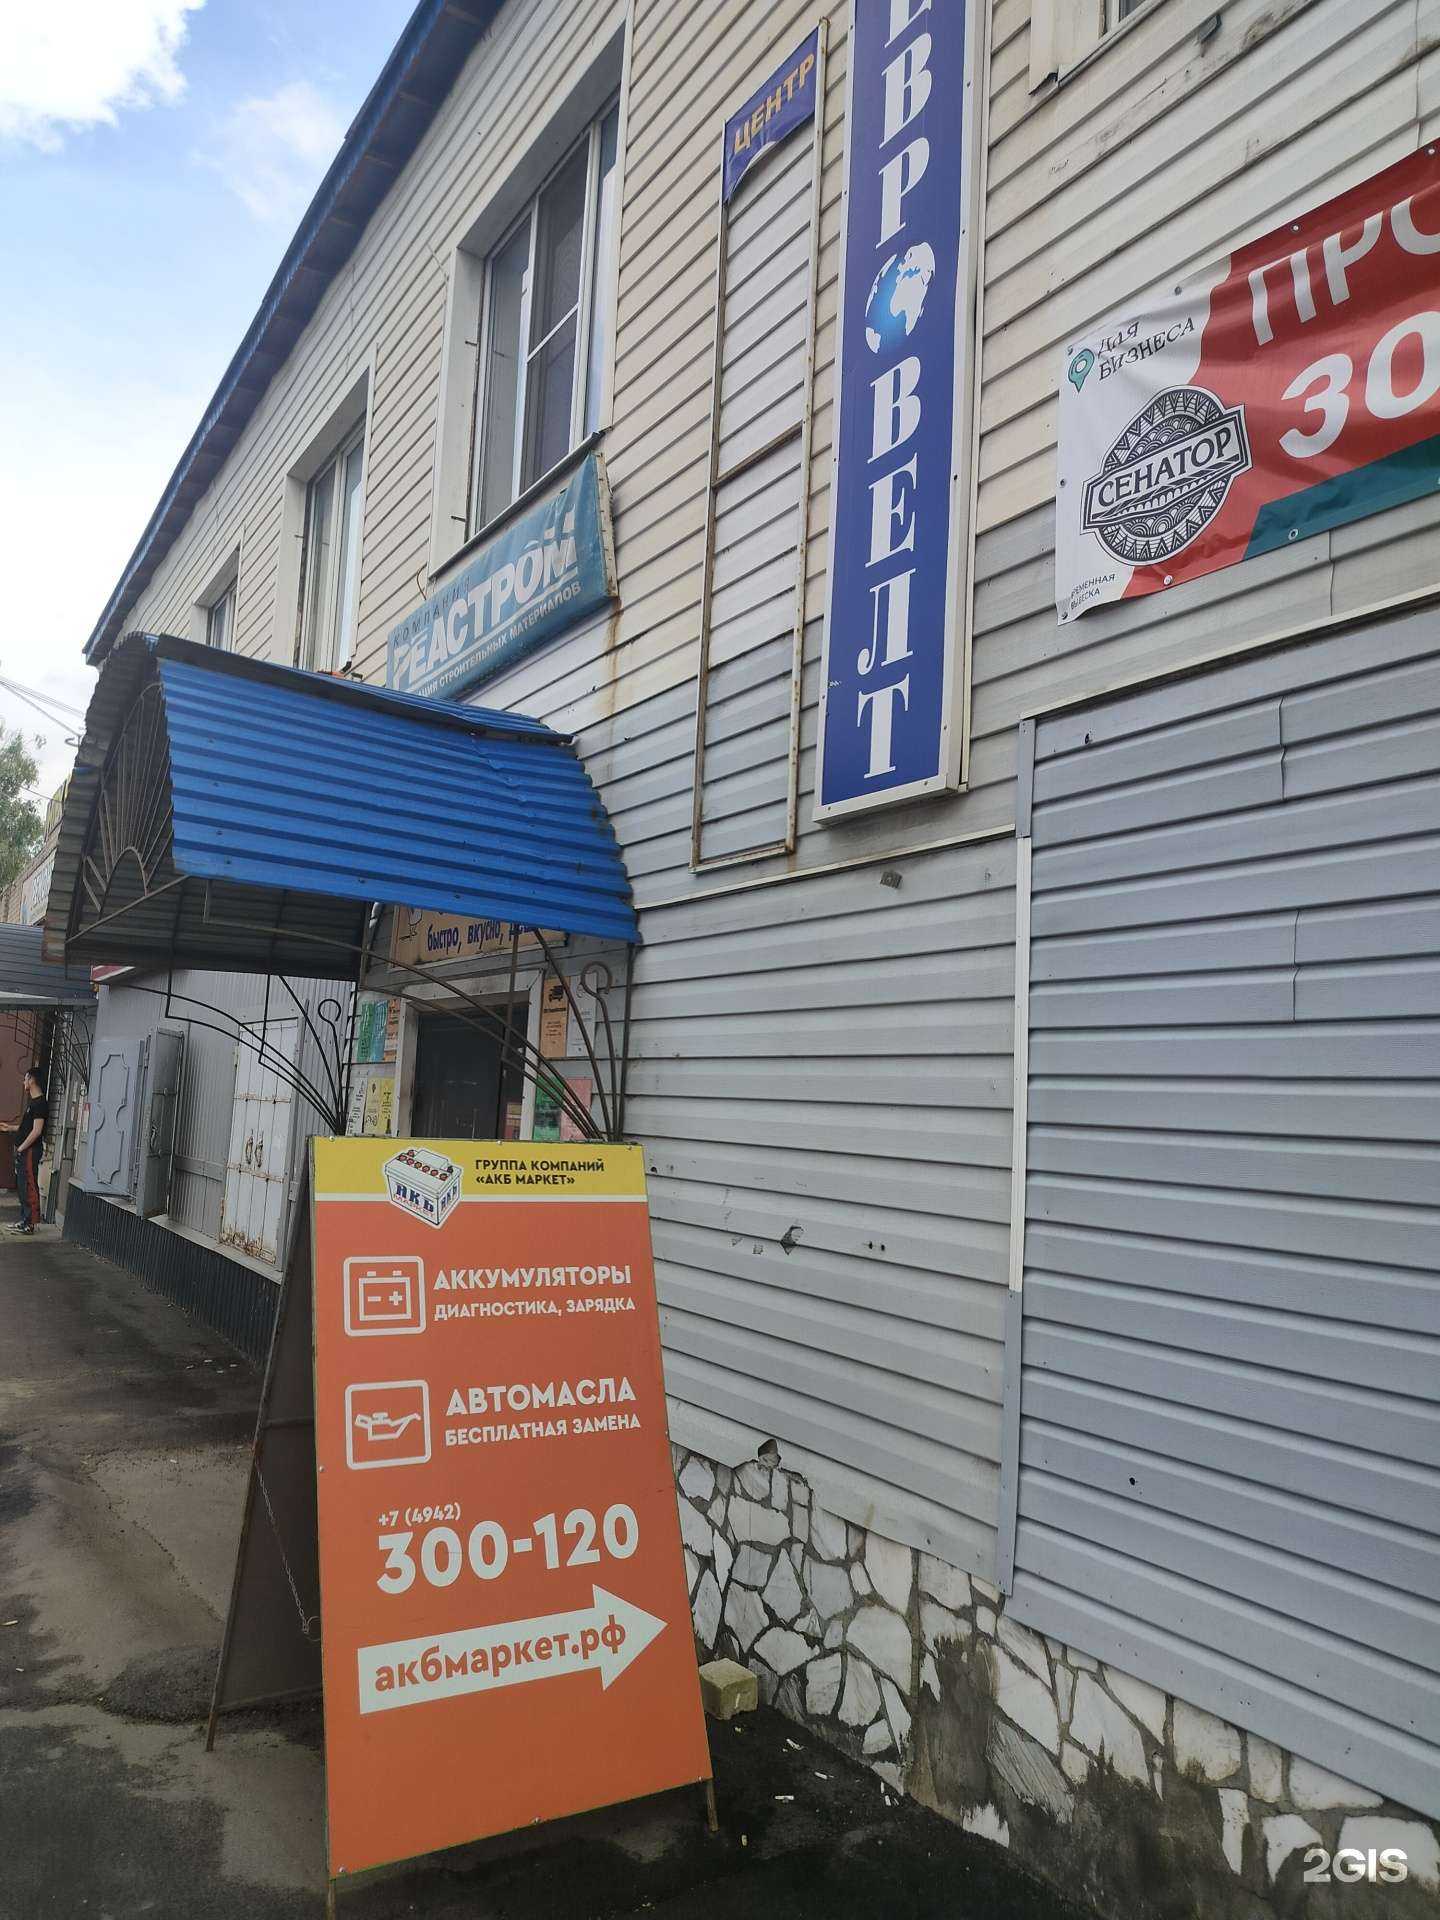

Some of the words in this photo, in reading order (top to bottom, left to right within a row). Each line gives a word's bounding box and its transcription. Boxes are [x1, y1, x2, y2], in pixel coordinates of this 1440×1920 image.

[733, 53, 815, 154] ЦЕНТР
[1098, 316, 1195, 382] БИЗНЕСА
[1098, 426, 1232, 508] СЕНАТОР
[439, 633, 507, 688] СТРОИТЕЛЬНЫХ
[509, 580, 582, 641] МАТЕРИАЛОВ
[427, 922, 462, 955] быстро,
[466, 918, 504, 950] вкусно,
[475, 1159, 527, 1172] ГРУППА
[530, 1157, 605, 1172] КОМПАНИЙ
[475, 1173, 513, 1186] «АКБ
[515, 1173, 576, 1186] МАРКЕТ»
[433, 1265, 632, 1291] АККУМУЛЯТОРЫ
[433, 1300, 563, 1322] ДИАГНОСТИКА,
[566, 1297, 636, 1314] ЗАРЯДКА
[445, 1376, 637, 1417] АВТОМАСЛА
[445, 1420, 567, 1447] БЕСПЛАТНАЯ
[572, 1413, 641, 1434] ЗАМЕНА
[378, 1509, 399, 1528] +7
[404, 1501, 461, 1528] (4942)
[376, 1503, 640, 1595] 300-120
[374, 1614, 627, 1692] акбмаркет.рф
